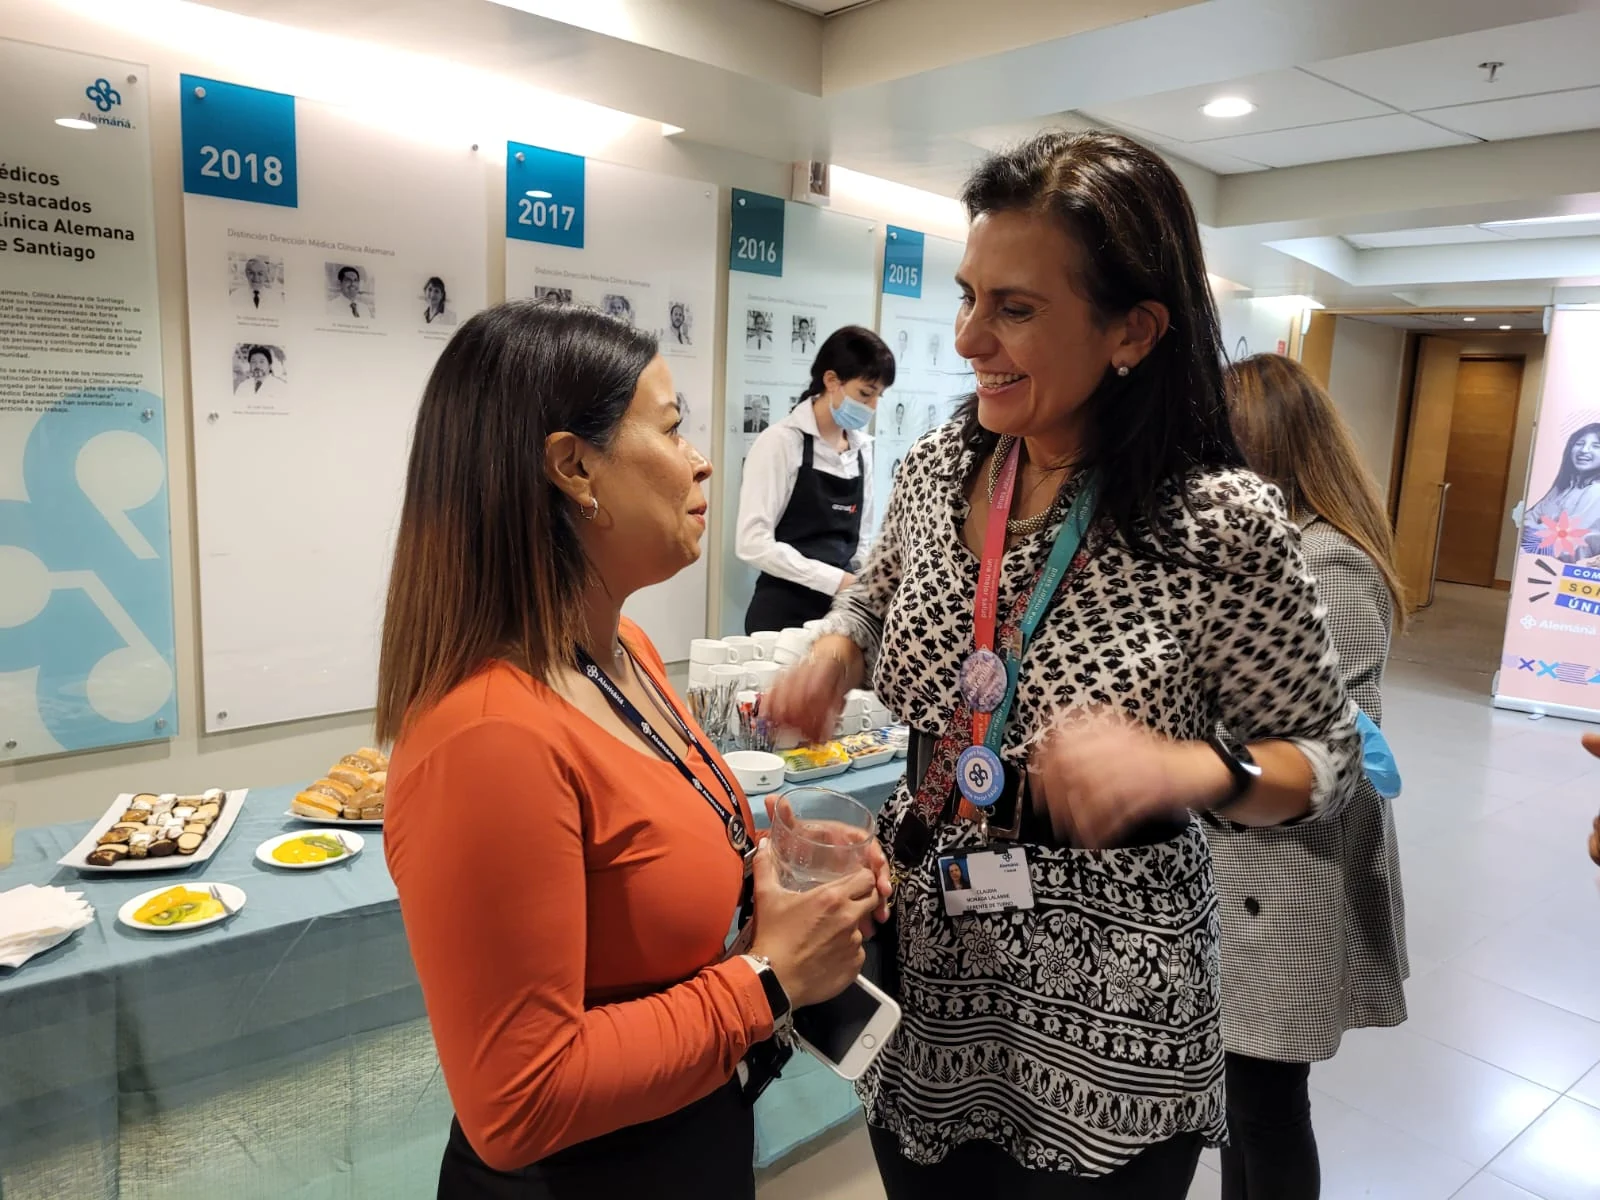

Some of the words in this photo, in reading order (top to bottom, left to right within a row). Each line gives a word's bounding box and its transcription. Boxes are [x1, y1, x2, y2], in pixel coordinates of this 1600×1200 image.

[0, 163, 60, 186] édicos
[200, 145, 283, 187] 2018
[0, 191, 92, 214] estacados
[518, 198, 576, 231] 2017
[0, 211, 48, 232] ínica
[54, 218, 135, 241] Alemana
[13, 237, 96, 262] Santiago
[227, 228, 269, 242] Distinción
[308, 239, 336, 250] Médica
[737, 236, 777, 264] 2016
[888, 264, 919, 288] 2015
[1032, 588, 1048, 611] mejor
[1568, 597, 1600, 614] ÚNI
